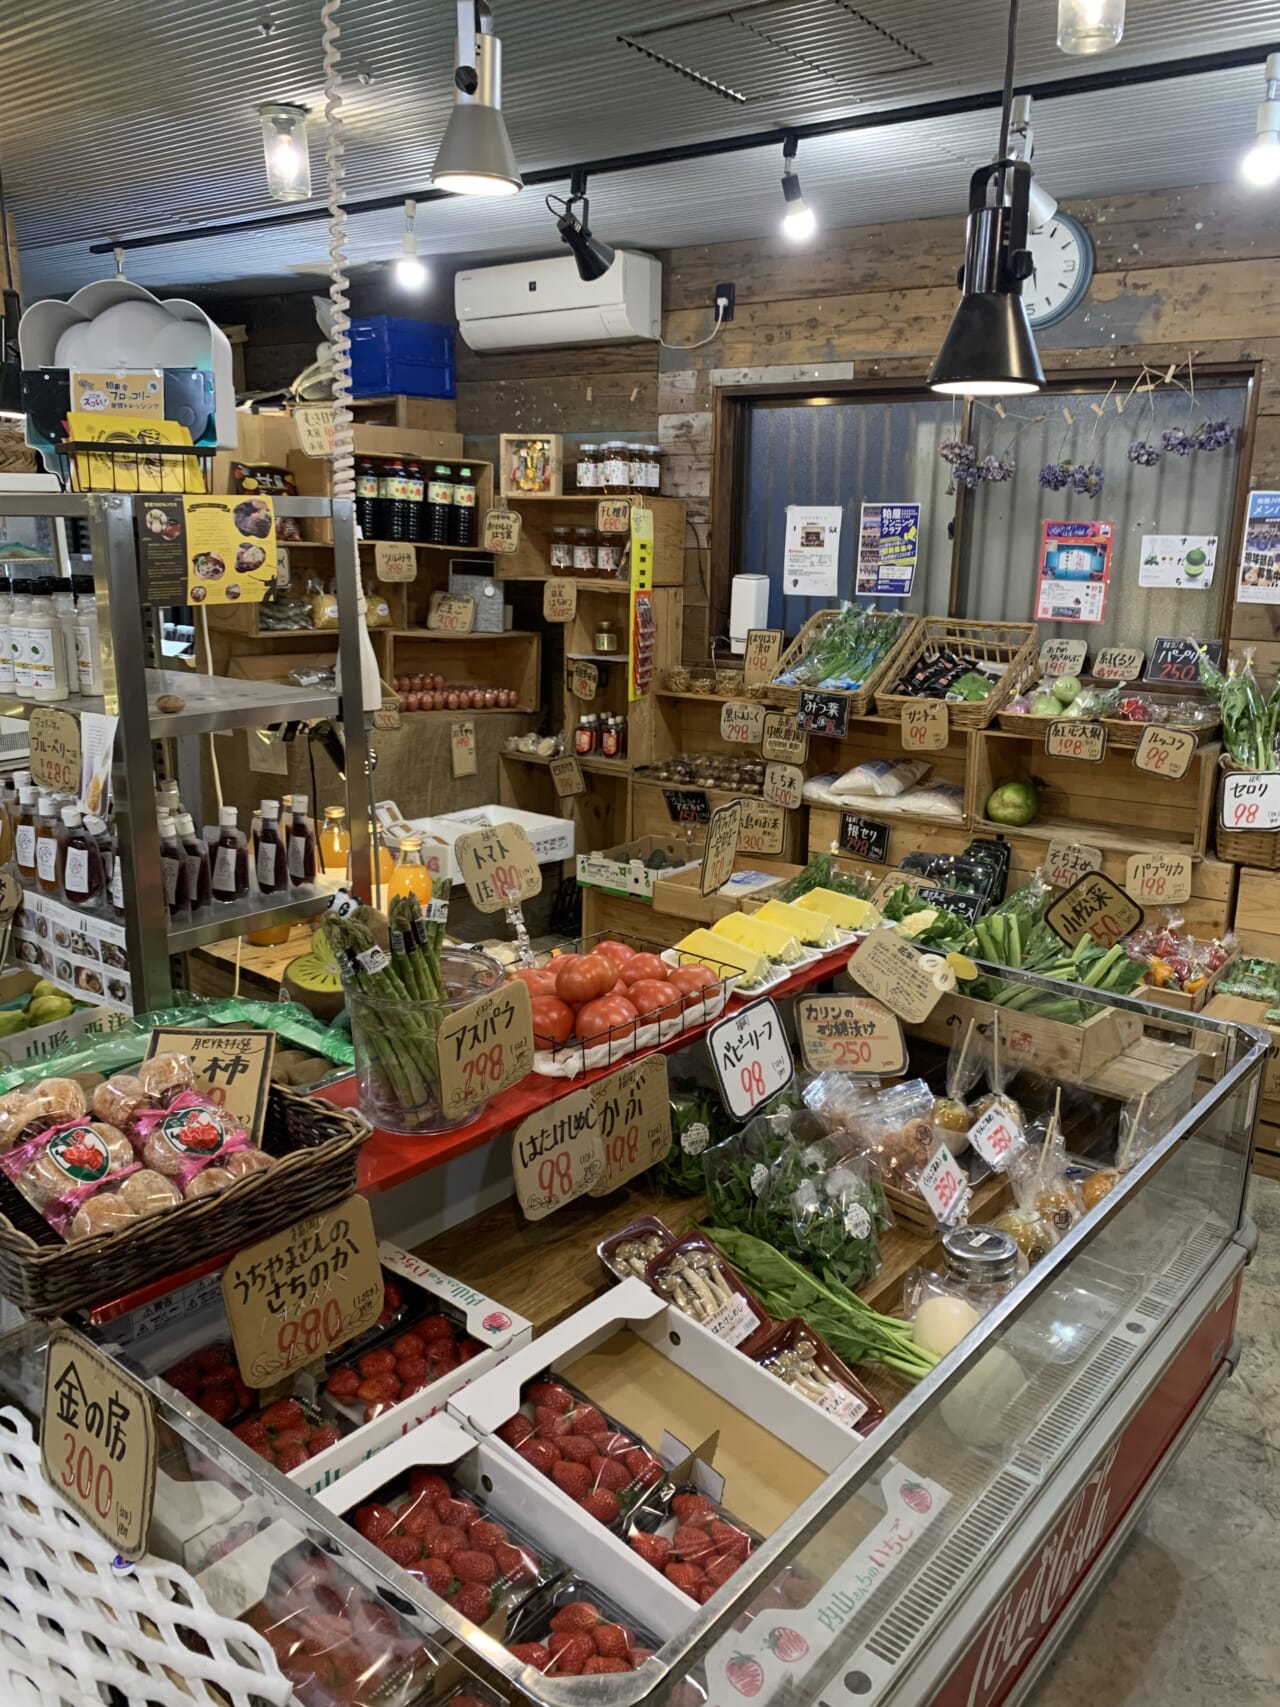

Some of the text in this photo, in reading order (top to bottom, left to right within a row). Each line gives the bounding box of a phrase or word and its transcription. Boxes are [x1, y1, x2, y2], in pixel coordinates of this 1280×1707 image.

[881, 518, 915, 528] ランニング
[881, 526, 902, 535] クラブ
[1045, 661, 1067, 673] 198
[1099, 651, 1137, 667] 紅くるり
[1159, 663, 1196, 681] 250
[723, 707, 760, 723] 黒にんにく
[804, 700, 840, 718] みつ葉
[31, 732, 72, 754] ブルーベリー
[909, 726, 928, 745] 98
[1056, 738, 1083, 756] 198
[1145, 746, 1170, 770] 98
[39, 757, 71, 785] 1280
[1229, 782, 1269, 799] セロリ
[1233, 802, 1260, 827] 98
[847, 823, 878, 844] 根セリ
[473, 839, 510, 870] トマト
[1049, 850, 1095, 872] そらまめ
[1132, 862, 1184, 880] パプリカ
[1139, 877, 1167, 897] 198
[1062, 882, 1114, 935] 小松菜
[805, 1003, 854, 1021] カリンの
[444, 1000, 516, 1061] アスパラ
[722, 1020, 773, 1072] ベビーリーフ
[832, 1040, 872, 1066] 250
[739, 1060, 766, 1107] 98
[597, 1076, 646, 1138] かぶ
[518, 1098, 597, 1169] はたけしめじ
[605, 1124, 640, 1180] 198
[537, 1150, 574, 1201] 98
[232, 1219, 350, 1306] うちやまさんの
[266, 1237, 360, 1314] さちのか
[710, 1305, 744, 1335] はたけしめじ
[277, 1298, 344, 1370] 980
[60, 1432, 114, 1519] 300
[816, 1517, 915, 1634] 内山さんちのいちご
